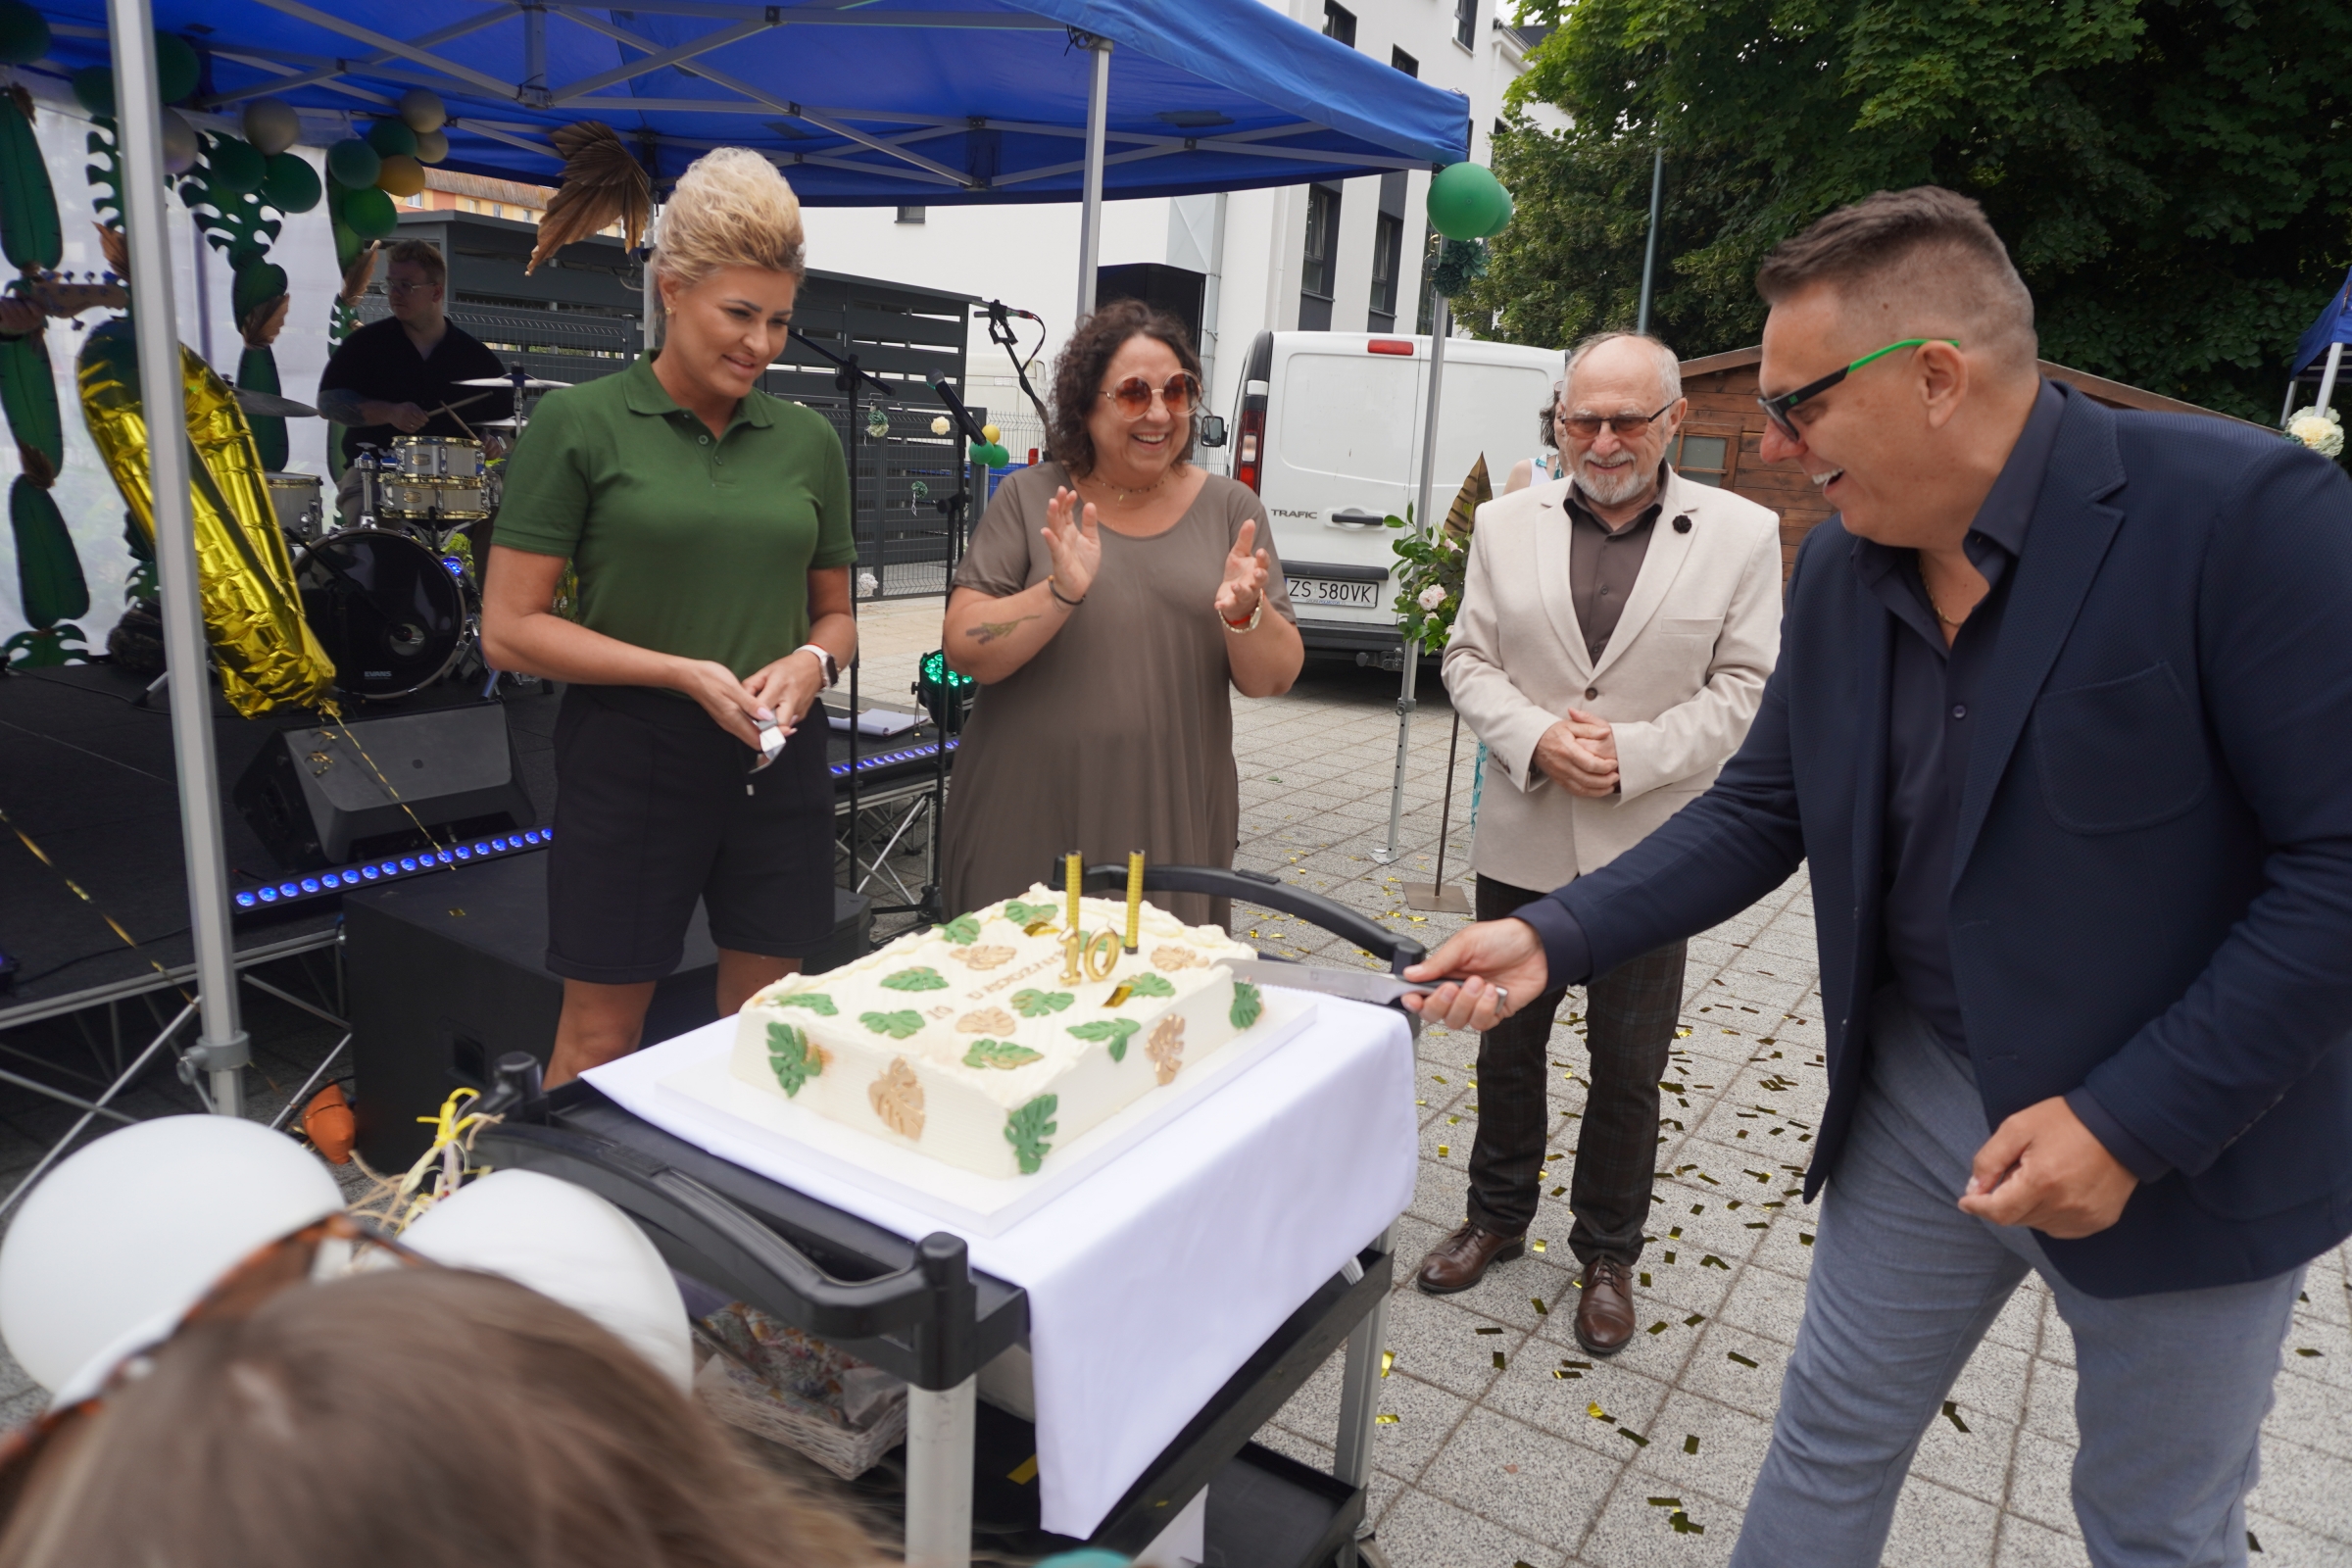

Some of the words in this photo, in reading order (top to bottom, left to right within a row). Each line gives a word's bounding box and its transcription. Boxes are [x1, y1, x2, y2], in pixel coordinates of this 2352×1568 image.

[1270, 509, 1317, 519] TRAFIC
[1289, 579, 1312, 598] ZS
[1318, 582, 1372, 603] 580VK
[1056, 925, 1120, 986] 10
